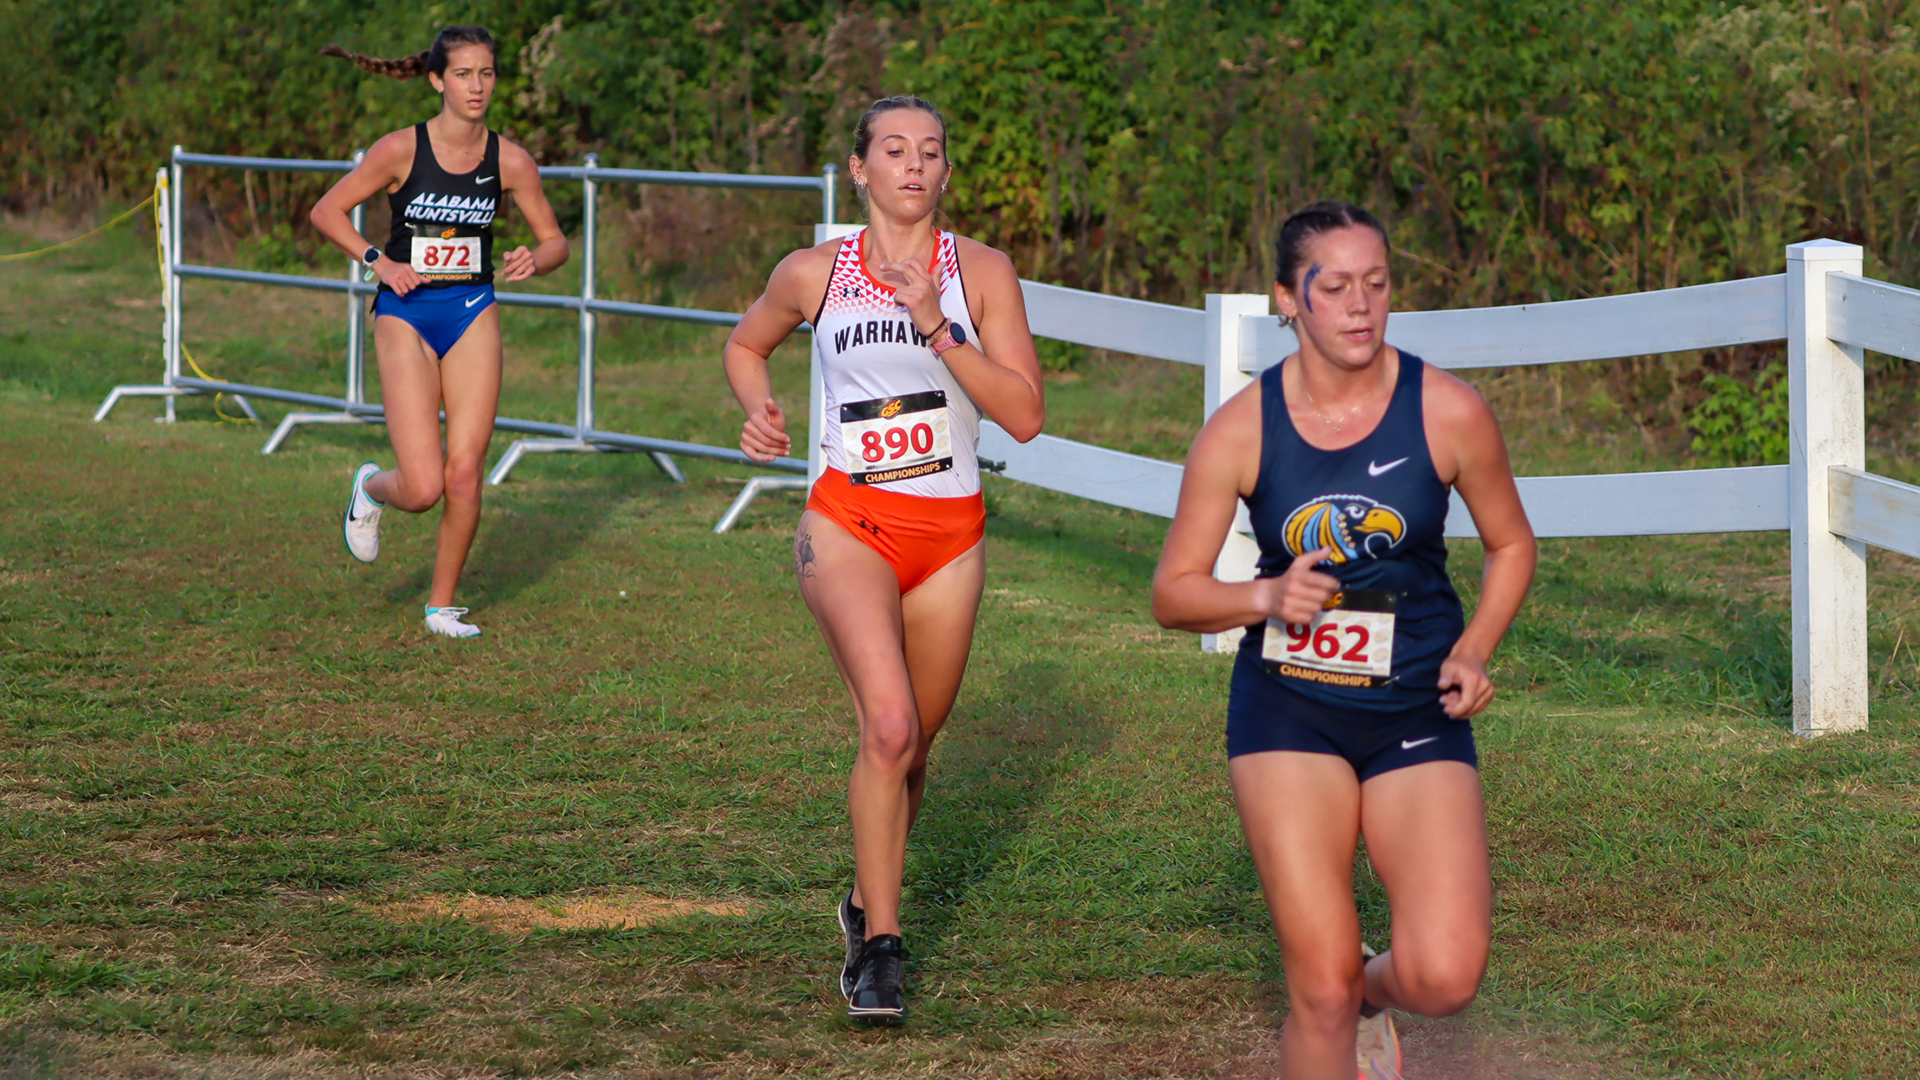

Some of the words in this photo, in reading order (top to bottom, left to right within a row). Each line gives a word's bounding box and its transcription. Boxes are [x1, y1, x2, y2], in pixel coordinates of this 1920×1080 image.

[410, 192, 496, 211] ALABAMA
[423, 245, 470, 267] 872
[422, 273, 473, 281] CHAMPIONSHIPS
[881, 399, 902, 418] GSC
[861, 422, 934, 463] 890
[865, 461, 941, 483] CHAMPIONSHIPS
[1286, 623, 1370, 663] 962
[1280, 664, 1372, 688] CHAMPIONSHIPS
